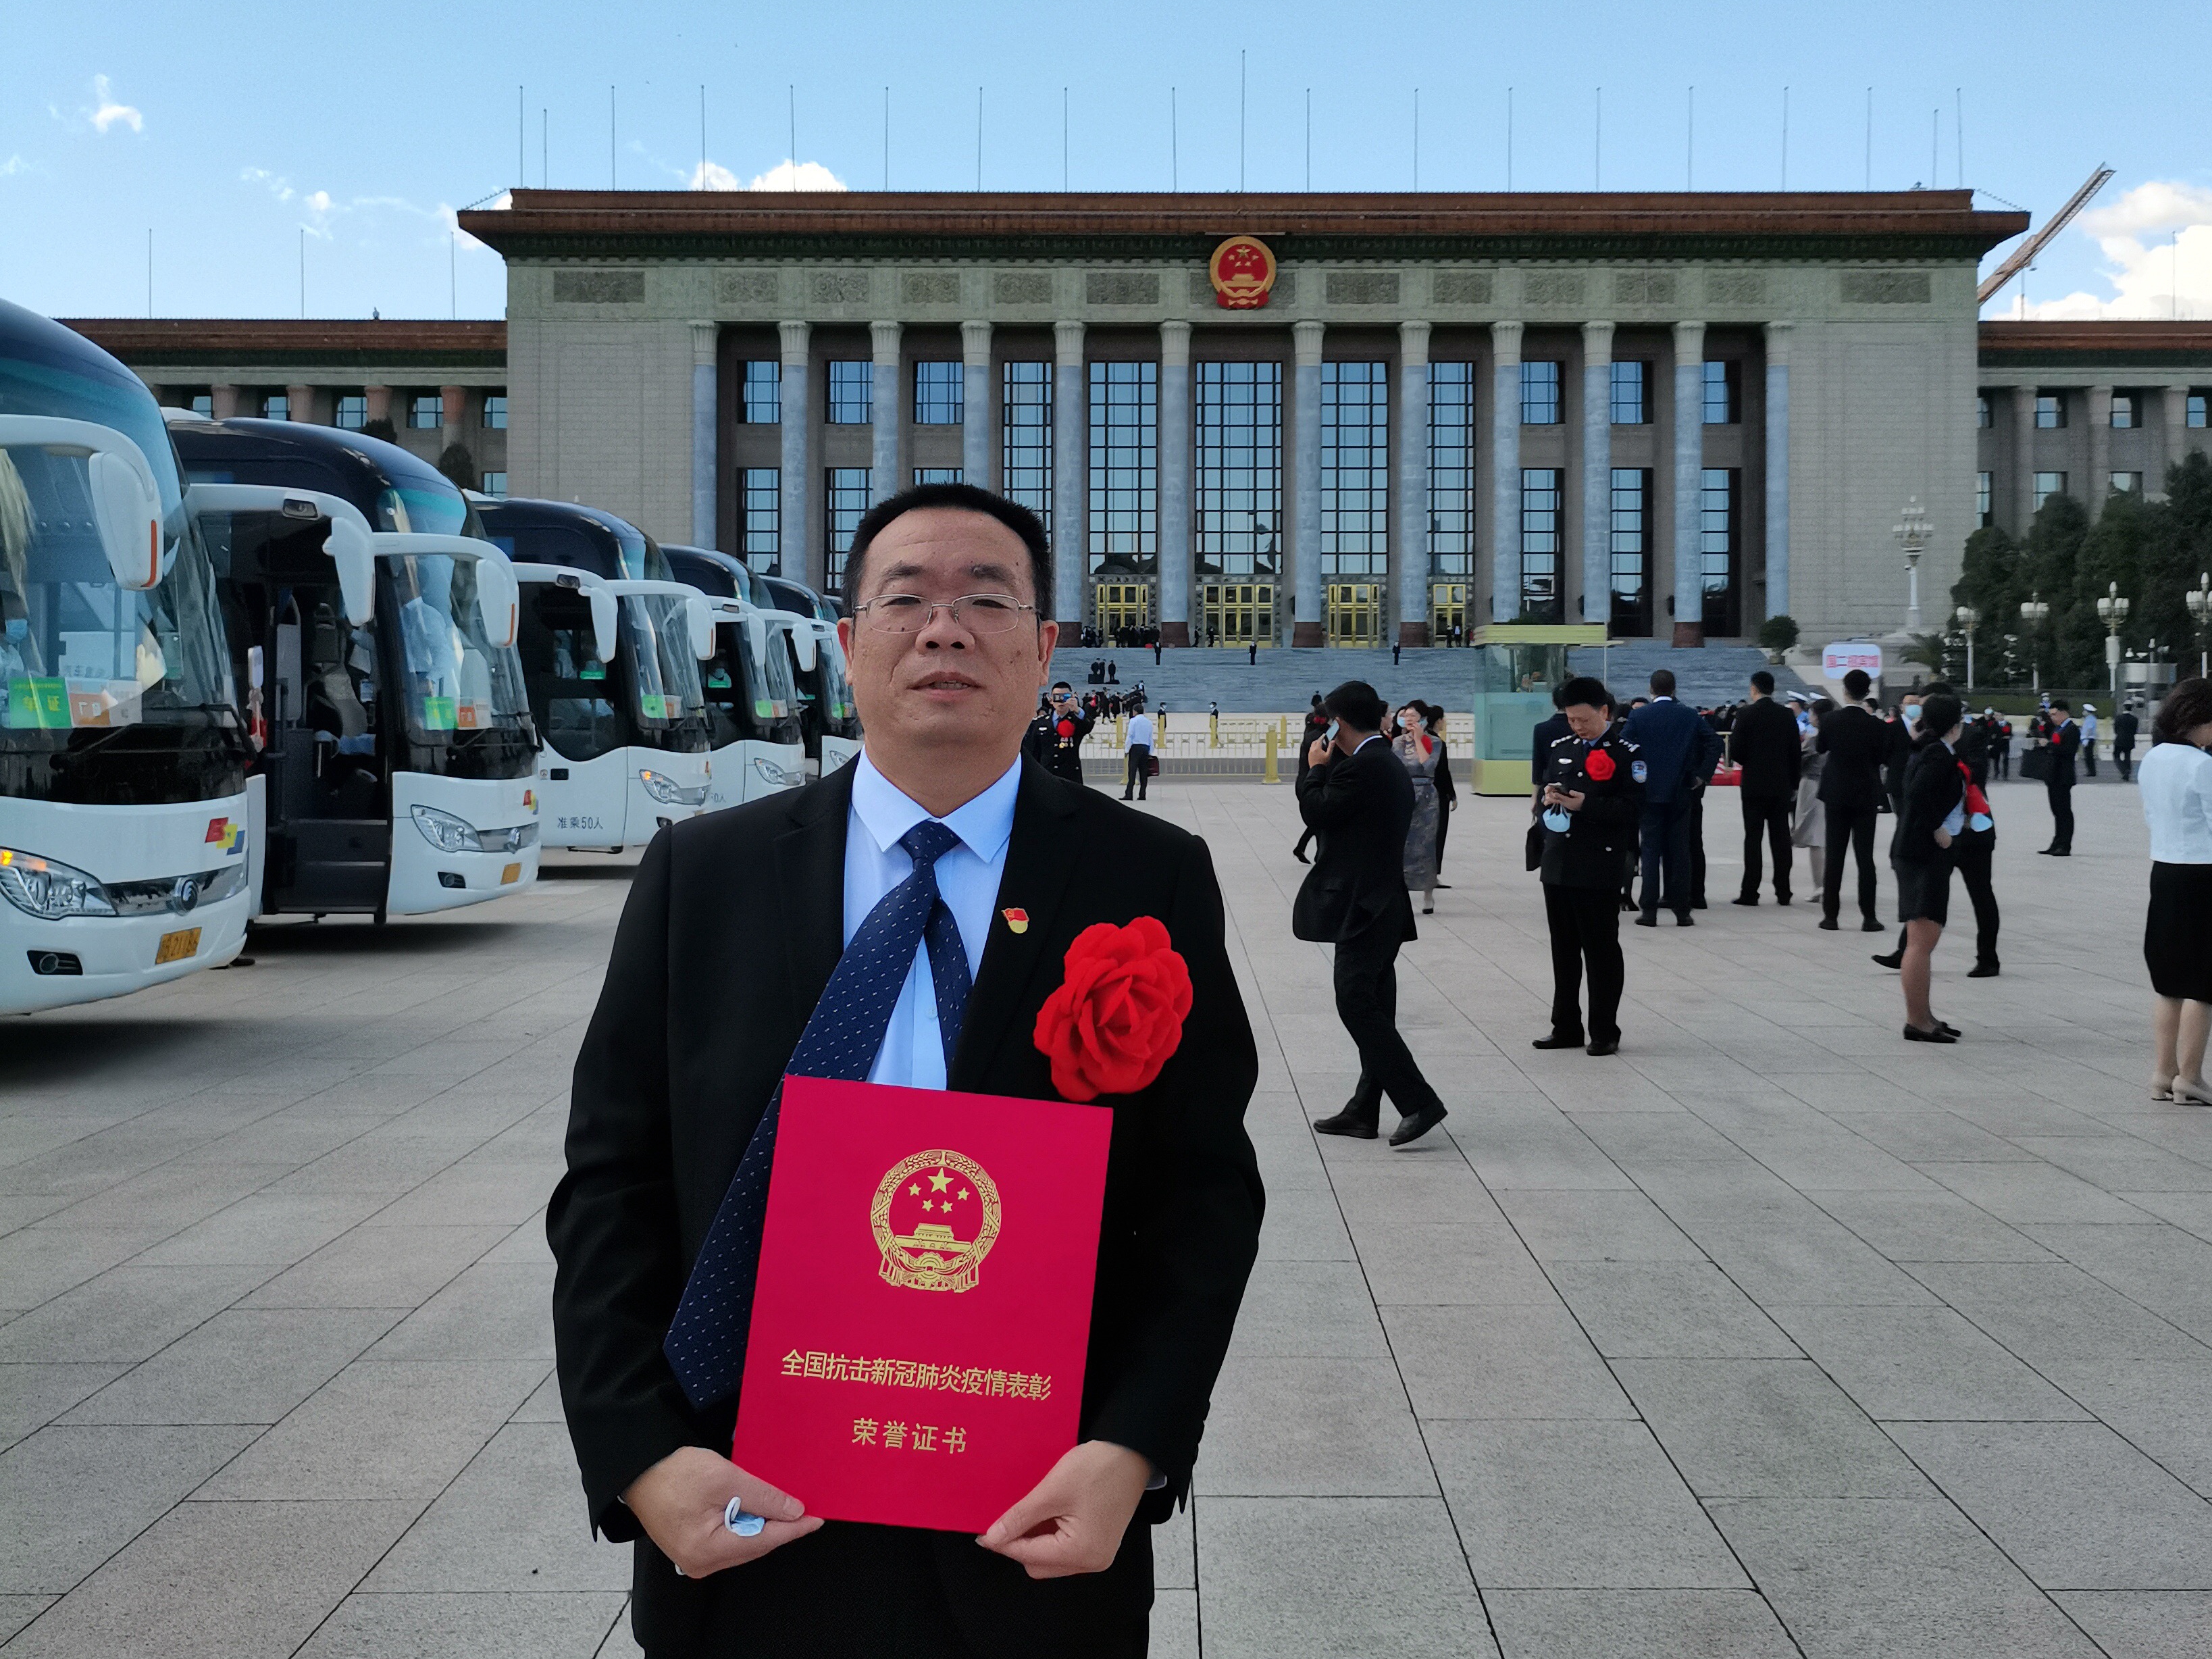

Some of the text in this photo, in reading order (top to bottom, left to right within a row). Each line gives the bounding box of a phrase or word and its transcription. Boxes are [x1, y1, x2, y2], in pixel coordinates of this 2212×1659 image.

[557, 816, 604, 830] 准乘50人
[781, 1349, 1052, 1401] 全国抗击新冠肺炎疫情表彰
[852, 1417, 967, 1454] 荣誉证书
